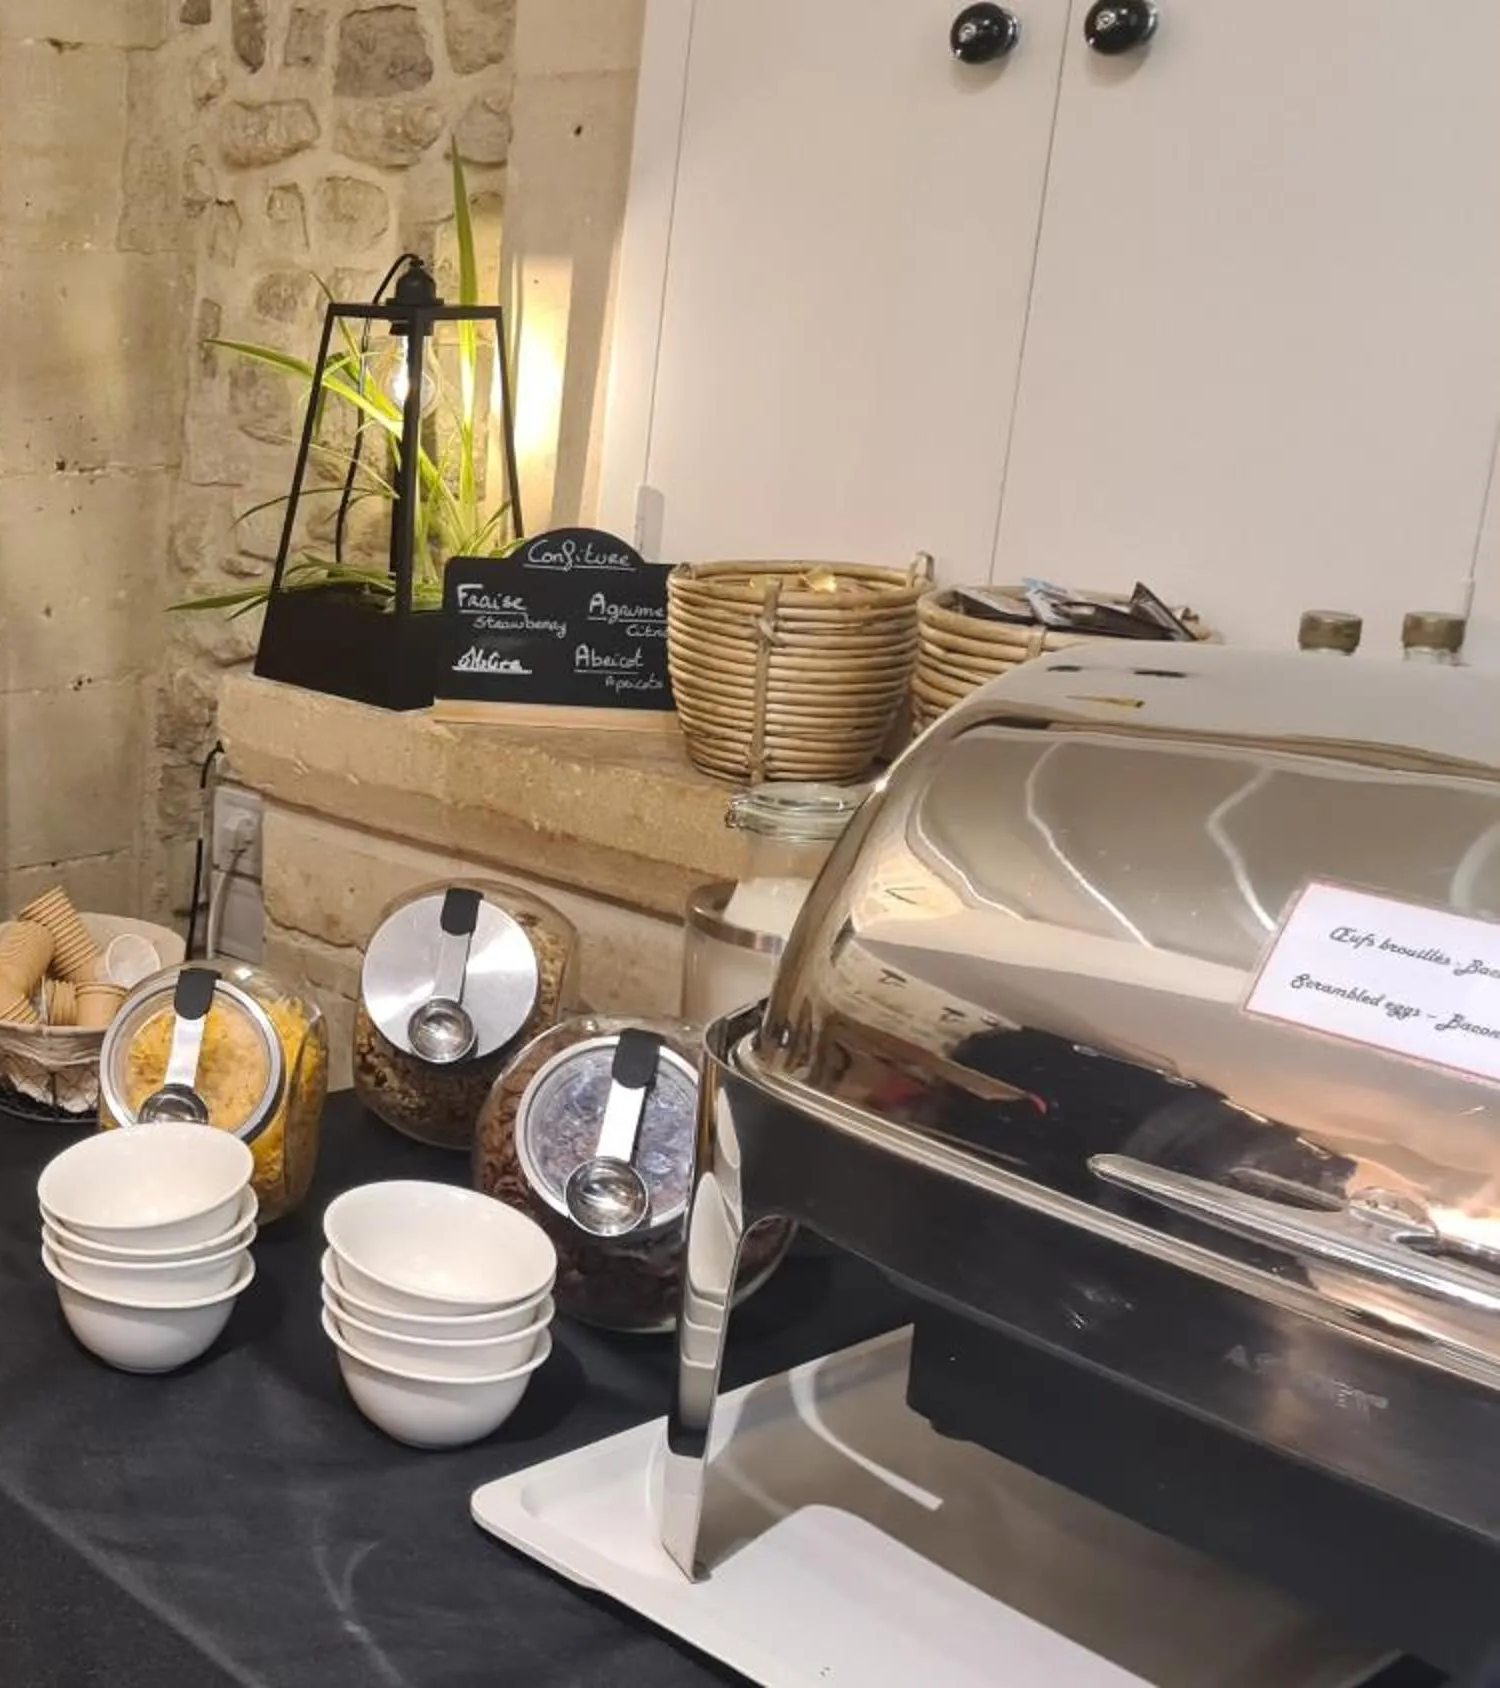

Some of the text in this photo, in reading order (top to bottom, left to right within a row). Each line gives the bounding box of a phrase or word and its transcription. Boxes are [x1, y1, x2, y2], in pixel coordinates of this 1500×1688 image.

[527, 540, 631, 571] Confiture
[457, 583, 527, 610] Fraise
[575, 644, 644, 669] Abricot
[1291, 973, 1387, 1007] Scrambled
[1384, 1001, 1421, 1021] eggs
